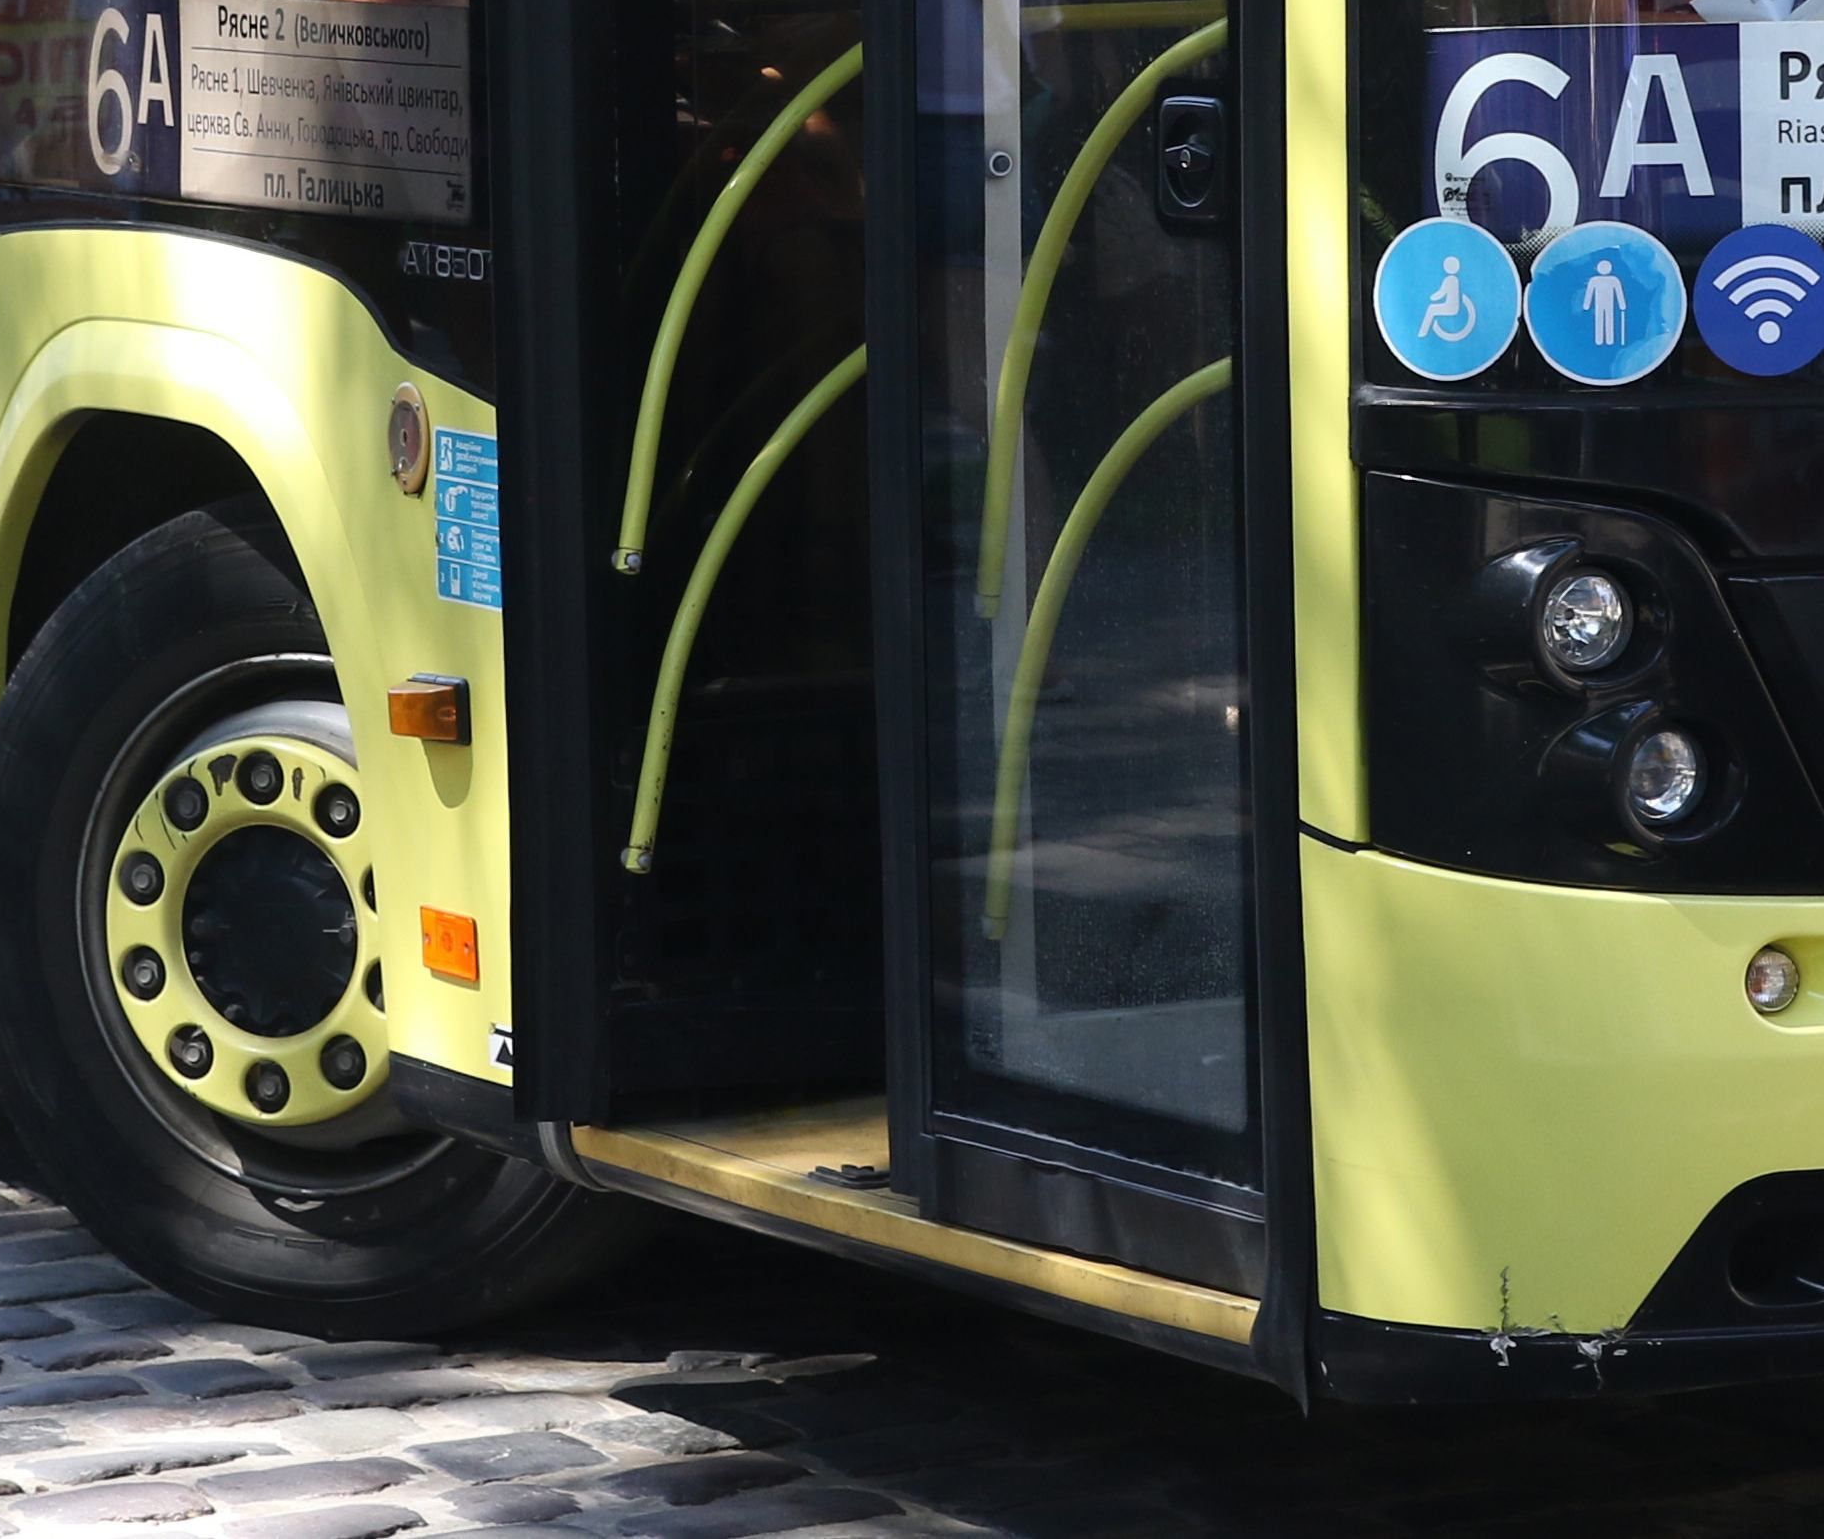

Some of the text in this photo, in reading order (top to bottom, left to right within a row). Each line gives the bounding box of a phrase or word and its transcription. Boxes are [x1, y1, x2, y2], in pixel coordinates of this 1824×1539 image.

[217, 5, 430, 51] Рясне 2 (Величковського)
[87, 6, 175, 176] 6А
[191, 62, 229, 93] Рясне
[247, 69, 320, 106] Шевченка,
[323, 74, 394, 107] Янівський
[397, 86, 464, 119] цвинтар,
[187, 111, 471, 159] церква Св. Анни, Городоцька, пр. Свободи
[264, 167, 384, 213] пл. Галицька
